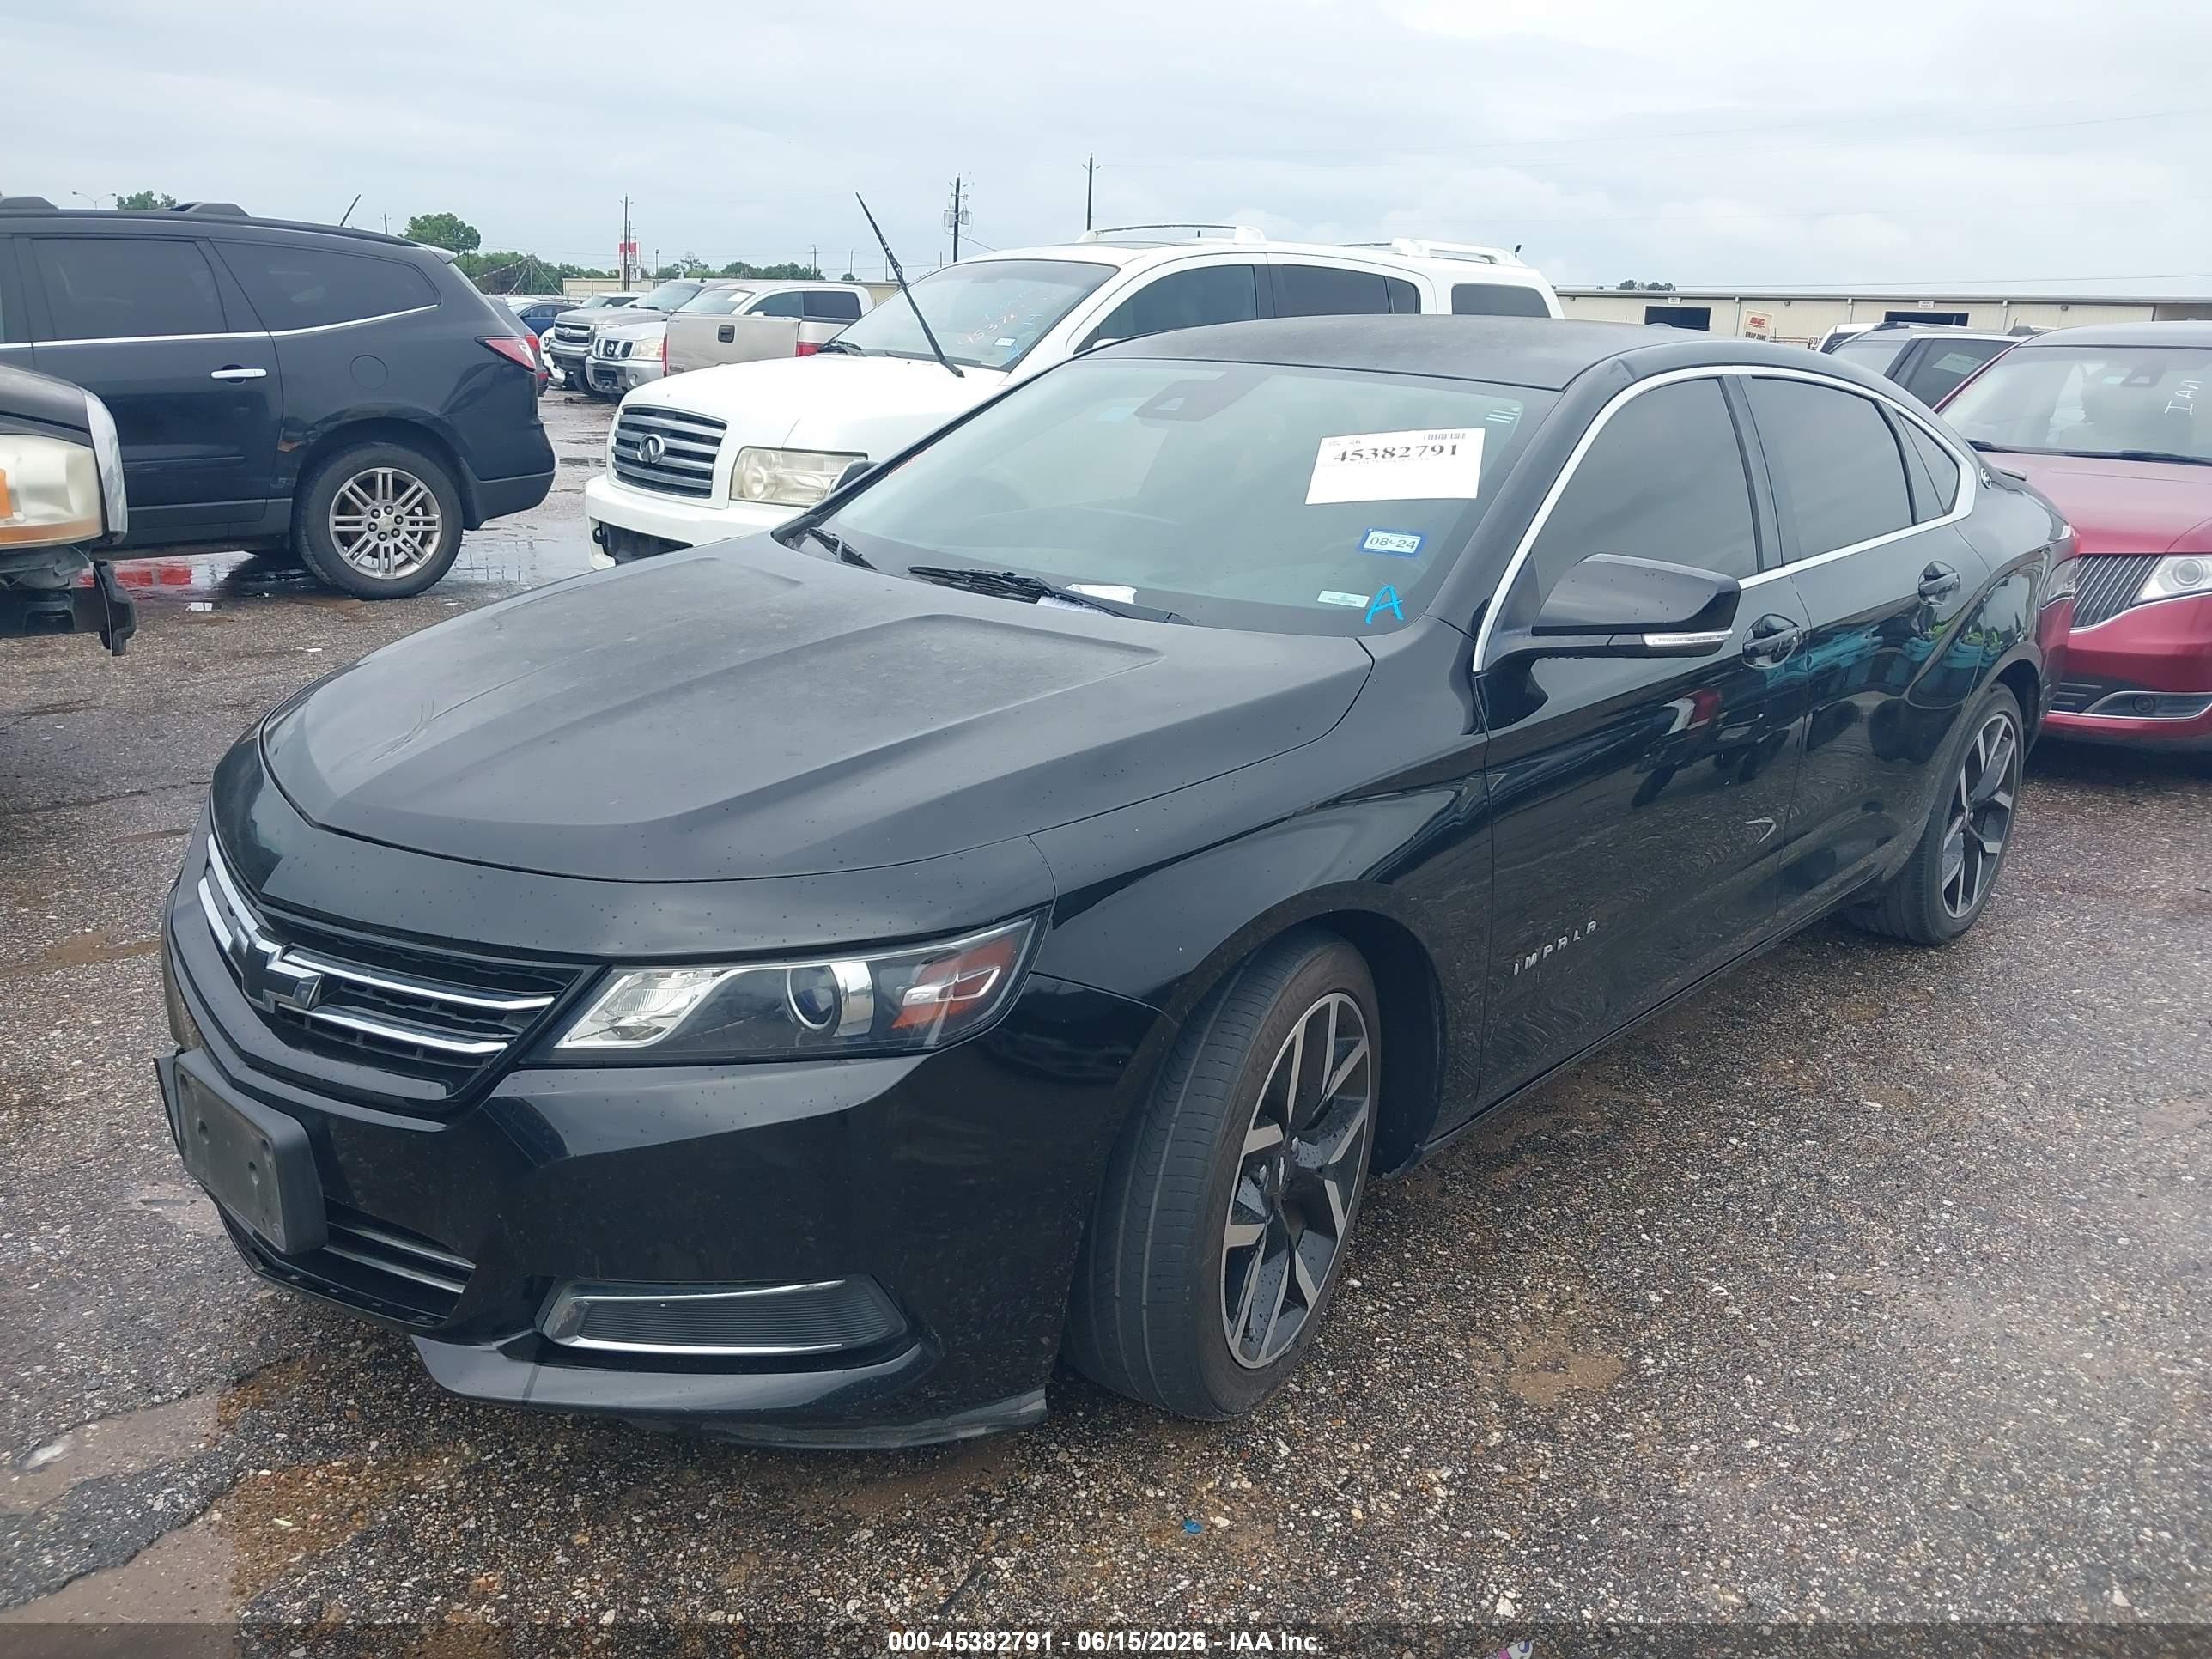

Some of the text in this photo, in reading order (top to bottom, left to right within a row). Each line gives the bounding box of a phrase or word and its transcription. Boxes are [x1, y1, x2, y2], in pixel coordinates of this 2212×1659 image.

[2163, 379, 2203, 416] IAA
[1333, 443, 1458, 463] 45382791
[1370, 537, 1417, 550] 08 24
[1364, 583, 1404, 624] A
[1513, 920, 1597, 976] IMPALA
